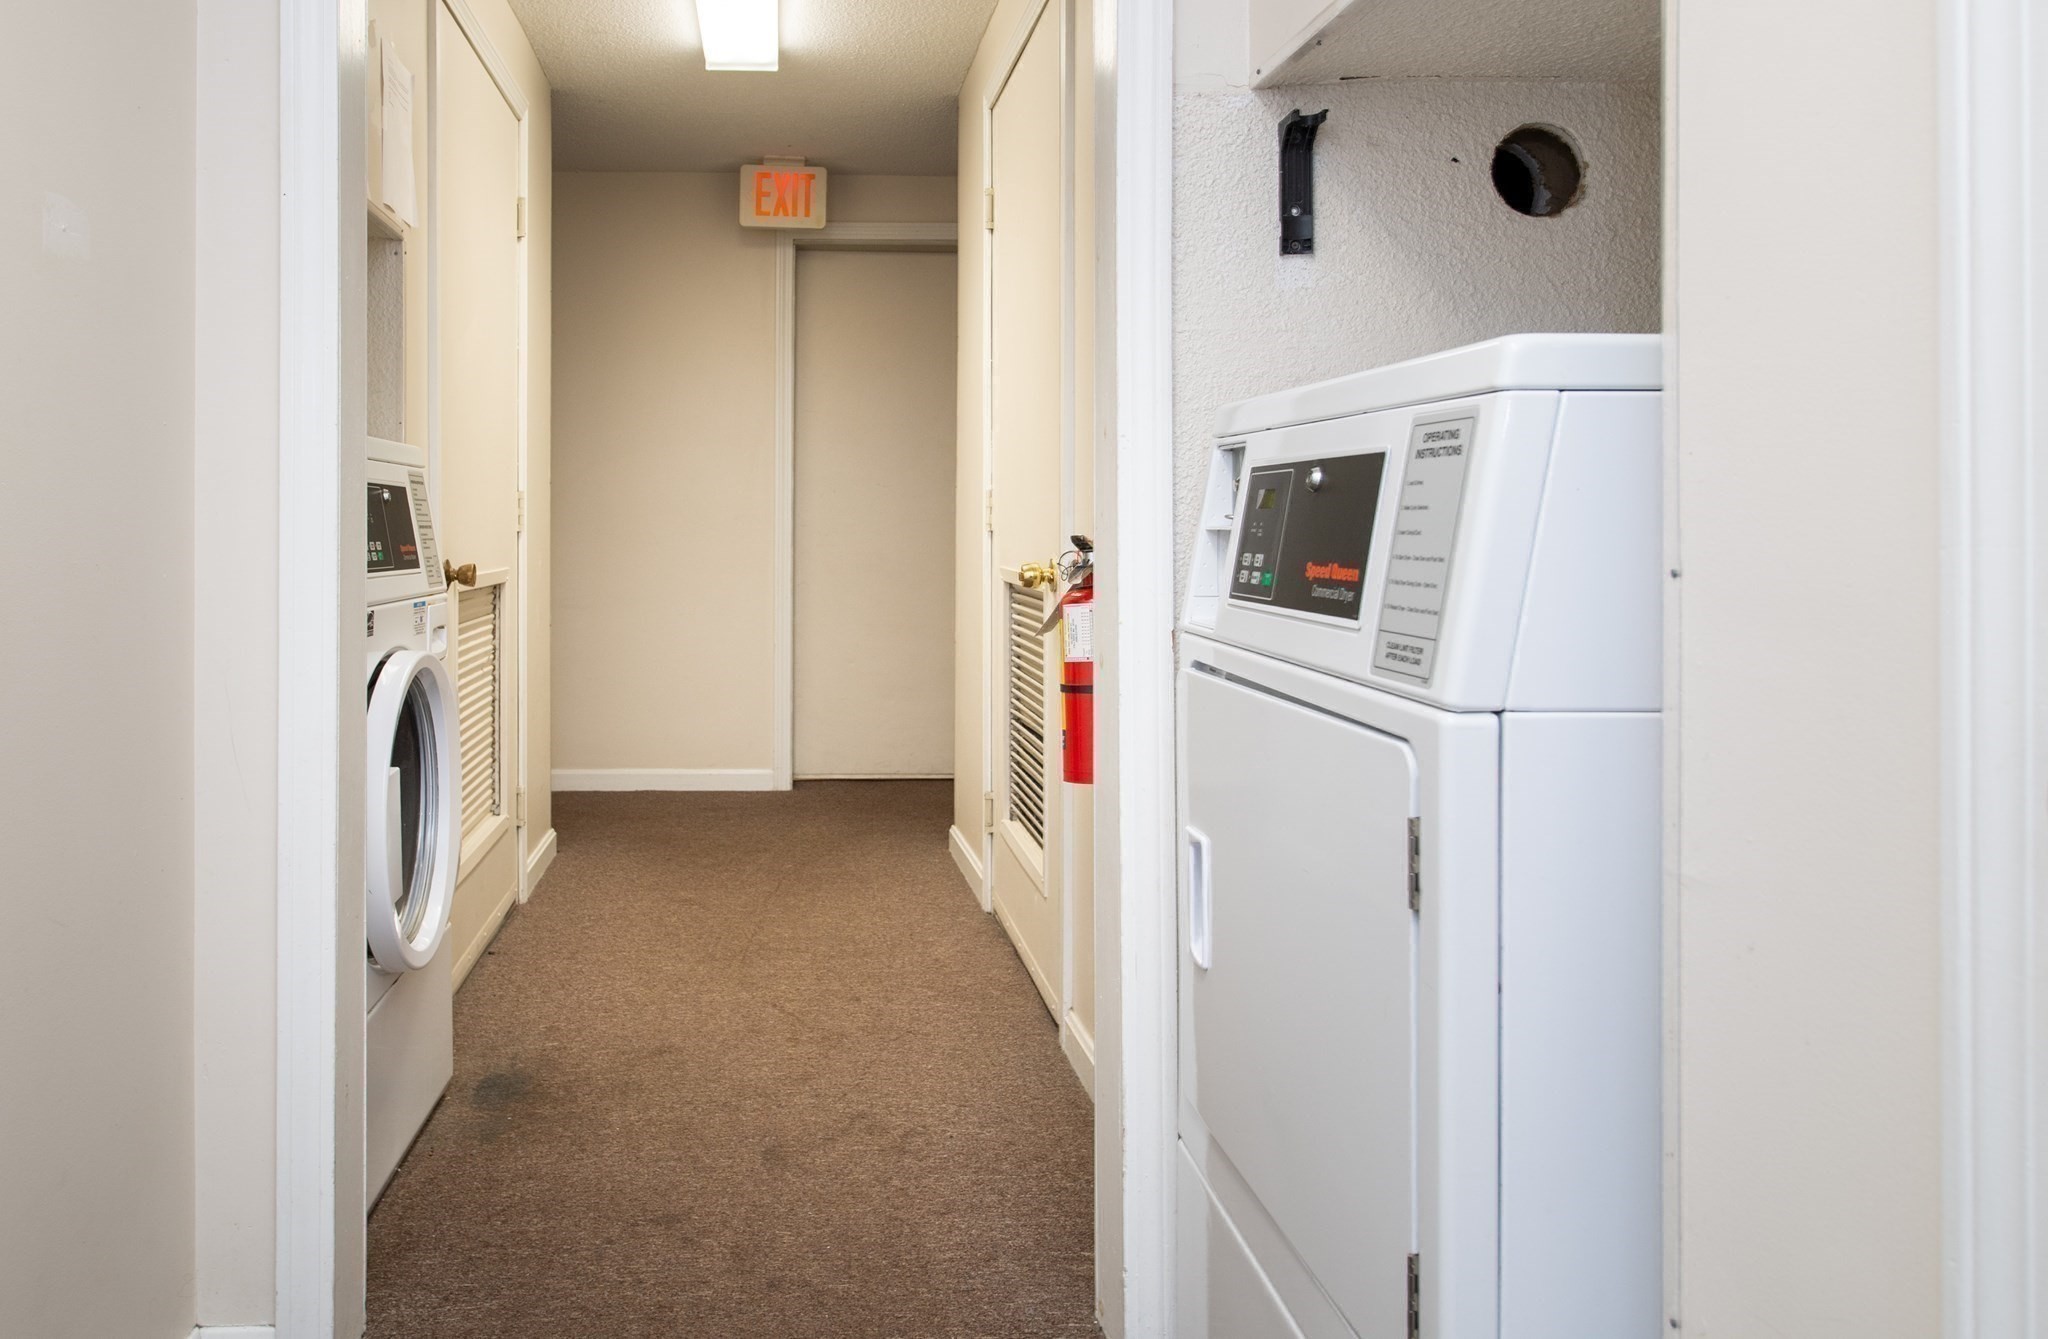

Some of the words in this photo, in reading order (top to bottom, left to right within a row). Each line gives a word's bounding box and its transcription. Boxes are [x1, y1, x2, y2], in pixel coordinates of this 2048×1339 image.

[755, 171, 816, 218] EXIT
[1423, 429, 1460, 443] OPERATING
[1415, 444, 1463, 459] INSTRUCTIONS
[1305, 562, 1332, 581] Speed
[1331, 563, 1359, 582] Queen
[1311, 584, 1339, 600] Commercial
[1339, 587, 1355, 603] Dryer
